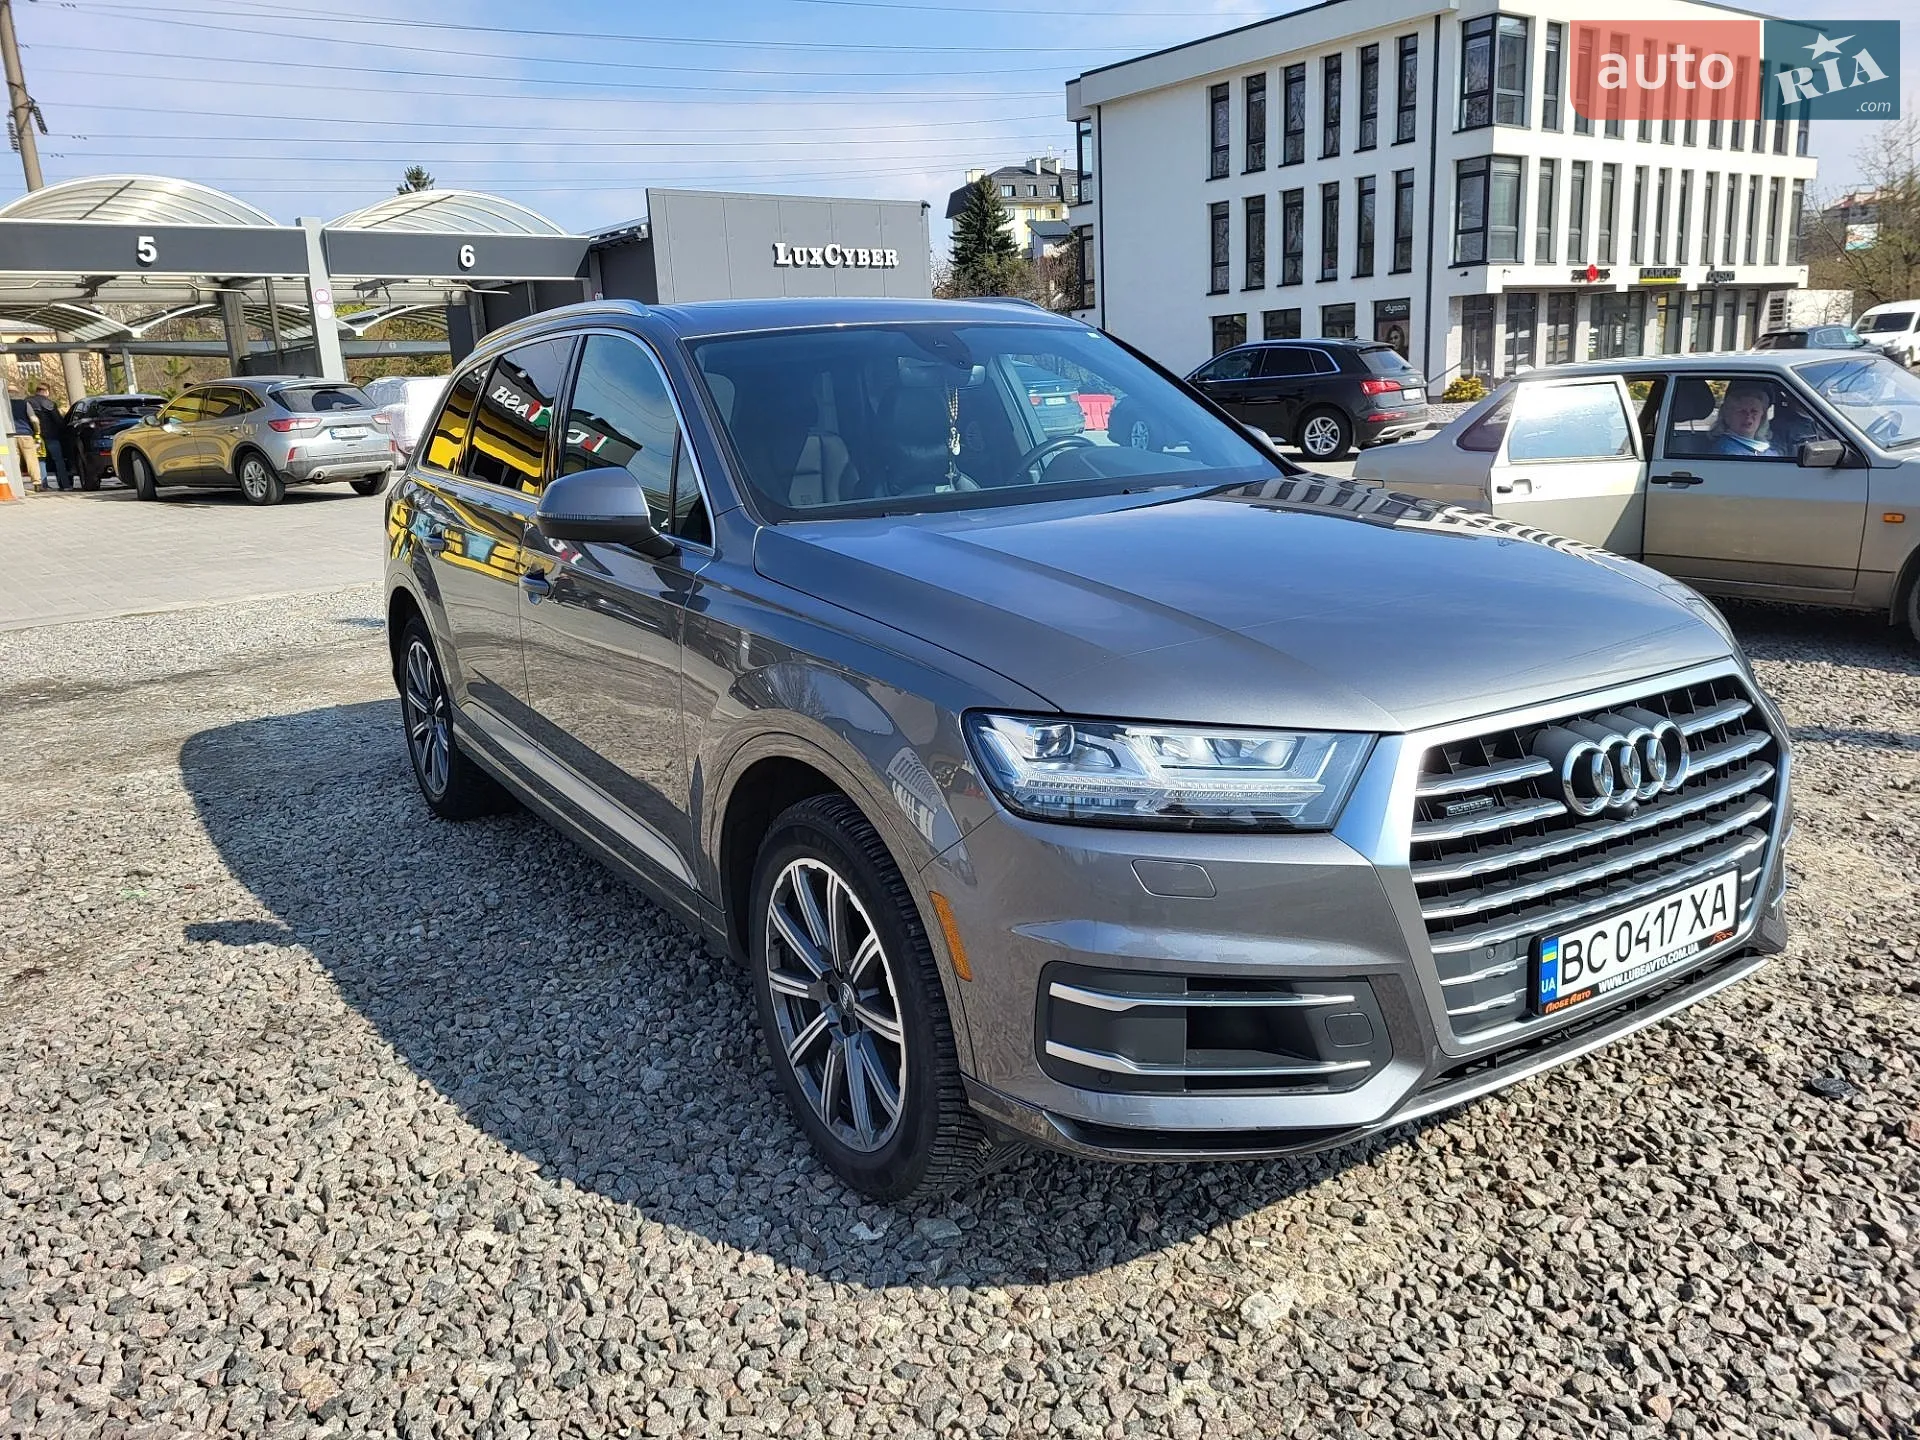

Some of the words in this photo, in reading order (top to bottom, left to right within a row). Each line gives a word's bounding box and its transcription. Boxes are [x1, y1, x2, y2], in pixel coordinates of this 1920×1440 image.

[137, 235, 158, 263] 5
[460, 244, 475, 268] 6
[1384, 303, 1407, 314] dyson
[1561, 931, 1608, 986] BC
[1616, 899, 1682, 963] 0417
[1688, 883, 1728, 935] XA
[1598, 943, 1700, 994] WWW.LUBEAVTO.COM.UA
[1541, 979, 1556, 993] UA
